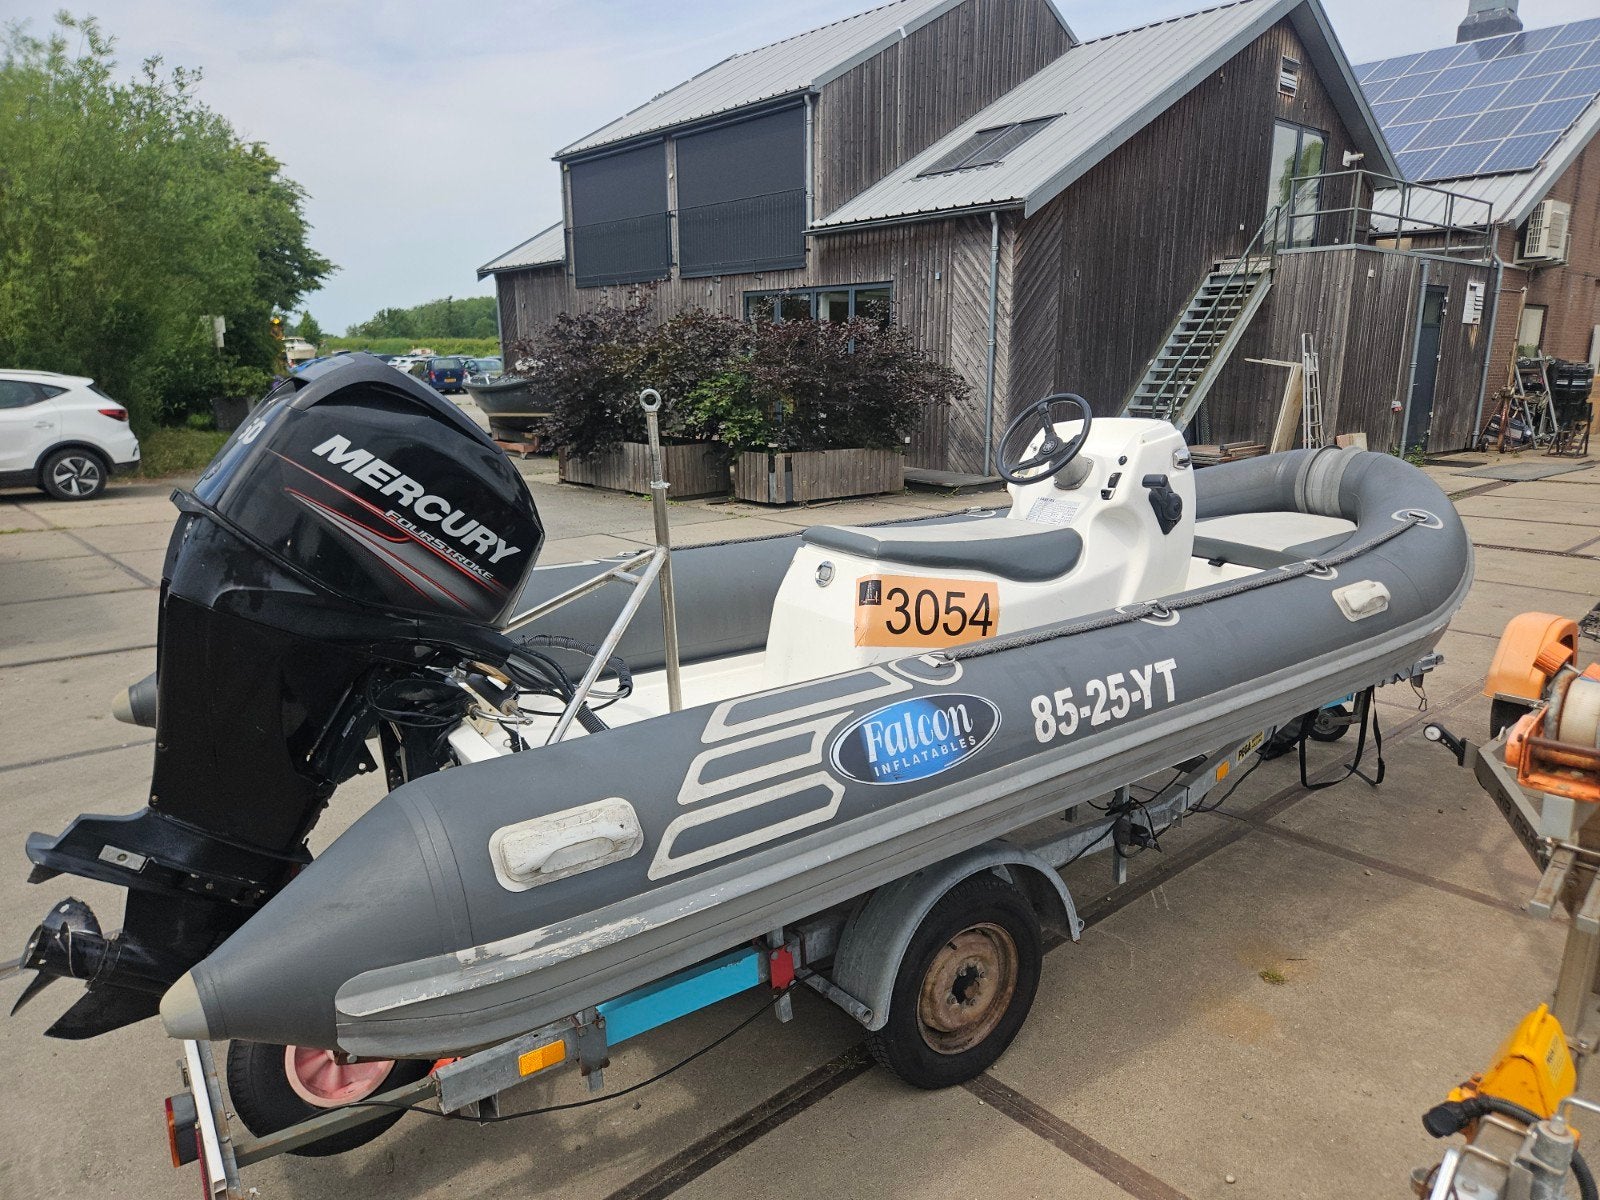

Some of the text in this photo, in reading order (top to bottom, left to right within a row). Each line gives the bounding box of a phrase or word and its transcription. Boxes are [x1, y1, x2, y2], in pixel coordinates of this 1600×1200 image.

[311, 434, 521, 564] MERCURY
[383, 509, 494, 581] FOURSTROKE
[885, 587, 993, 637] 3054
[862, 703, 974, 764] Falcon
[1030, 657, 1178, 744] 85-25-YT
[873, 734, 976, 778] INFLATABLES
